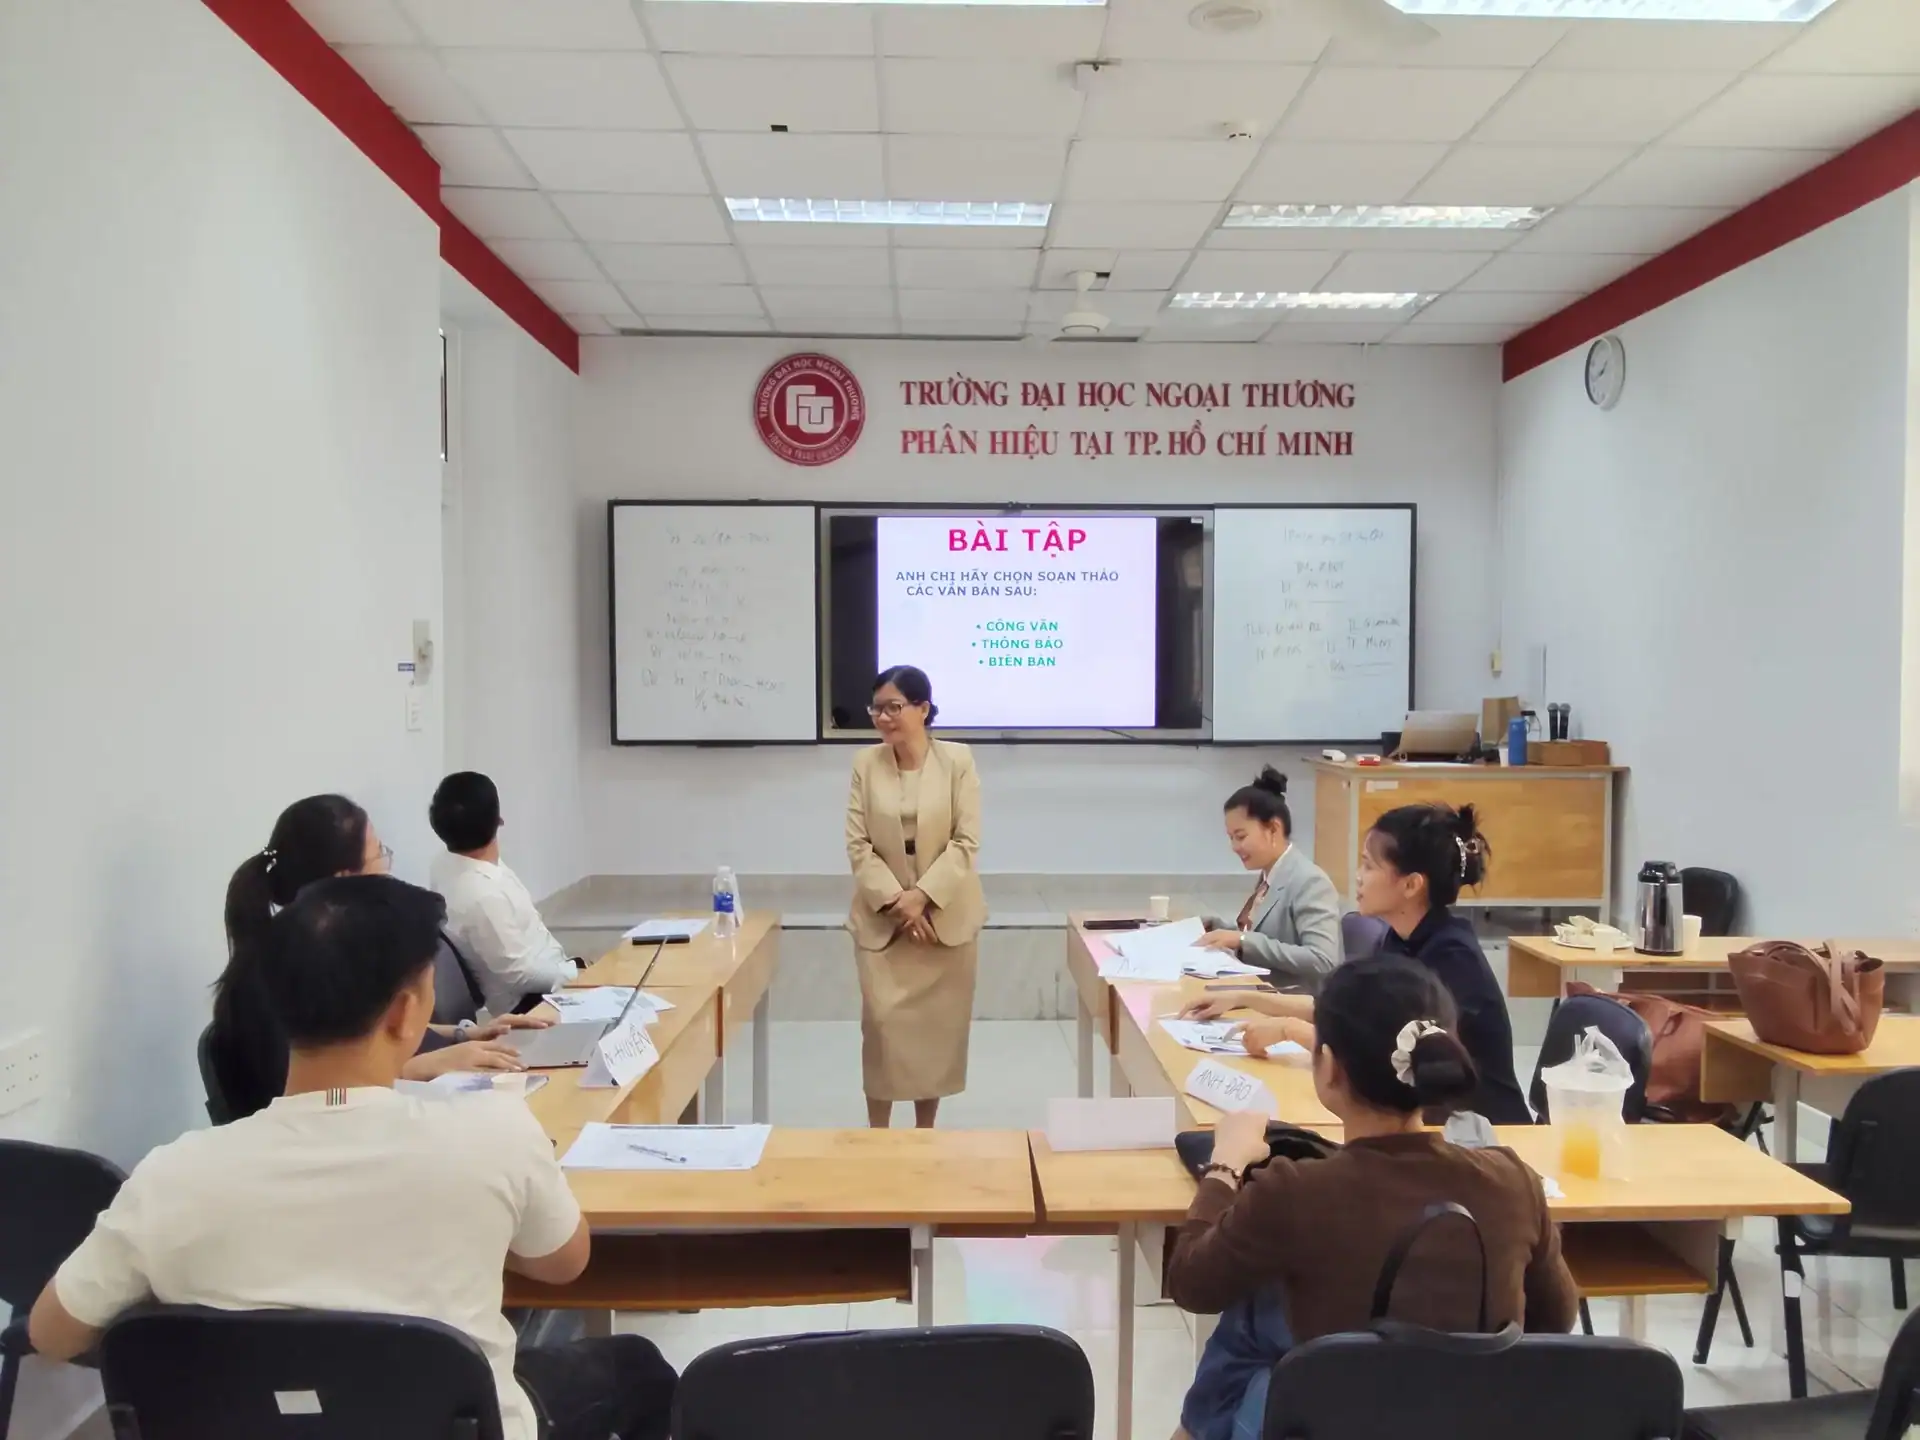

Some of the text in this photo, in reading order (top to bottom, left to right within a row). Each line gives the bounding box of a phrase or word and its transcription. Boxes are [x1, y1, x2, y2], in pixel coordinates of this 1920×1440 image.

[900, 371, 1355, 412] TRƯỜNG ĐẠI HỌC NGOẠI THƯƠNG
[900, 423, 978, 455] PHÂN
[988, 423, 1059, 460] HIỆU
[1070, 430, 1115, 460] TẠI
[1216, 424, 1268, 457] CHÍ
[1276, 430, 1354, 456] MINH
[948, 520, 1087, 558] BÀI TẬP
[896, 571, 925, 581] ANH
[961, 568, 988, 581] HÃY
[993, 571, 1033, 584] CHỌN
[1038, 571, 1076, 584] SOẠN
[1081, 567, 1119, 581] THẢO
[906, 583, 934, 596] CÁC
[972, 583, 1000, 596] BẢN
[1005, 585, 1037, 596] SAU:
[986, 617, 1058, 631] CÔNG VĂN
[982, 635, 1063, 648] THÔNG BÁO
[989, 653, 1022, 666] BIÊN
[1196, 1068, 1225, 1091] ANH
